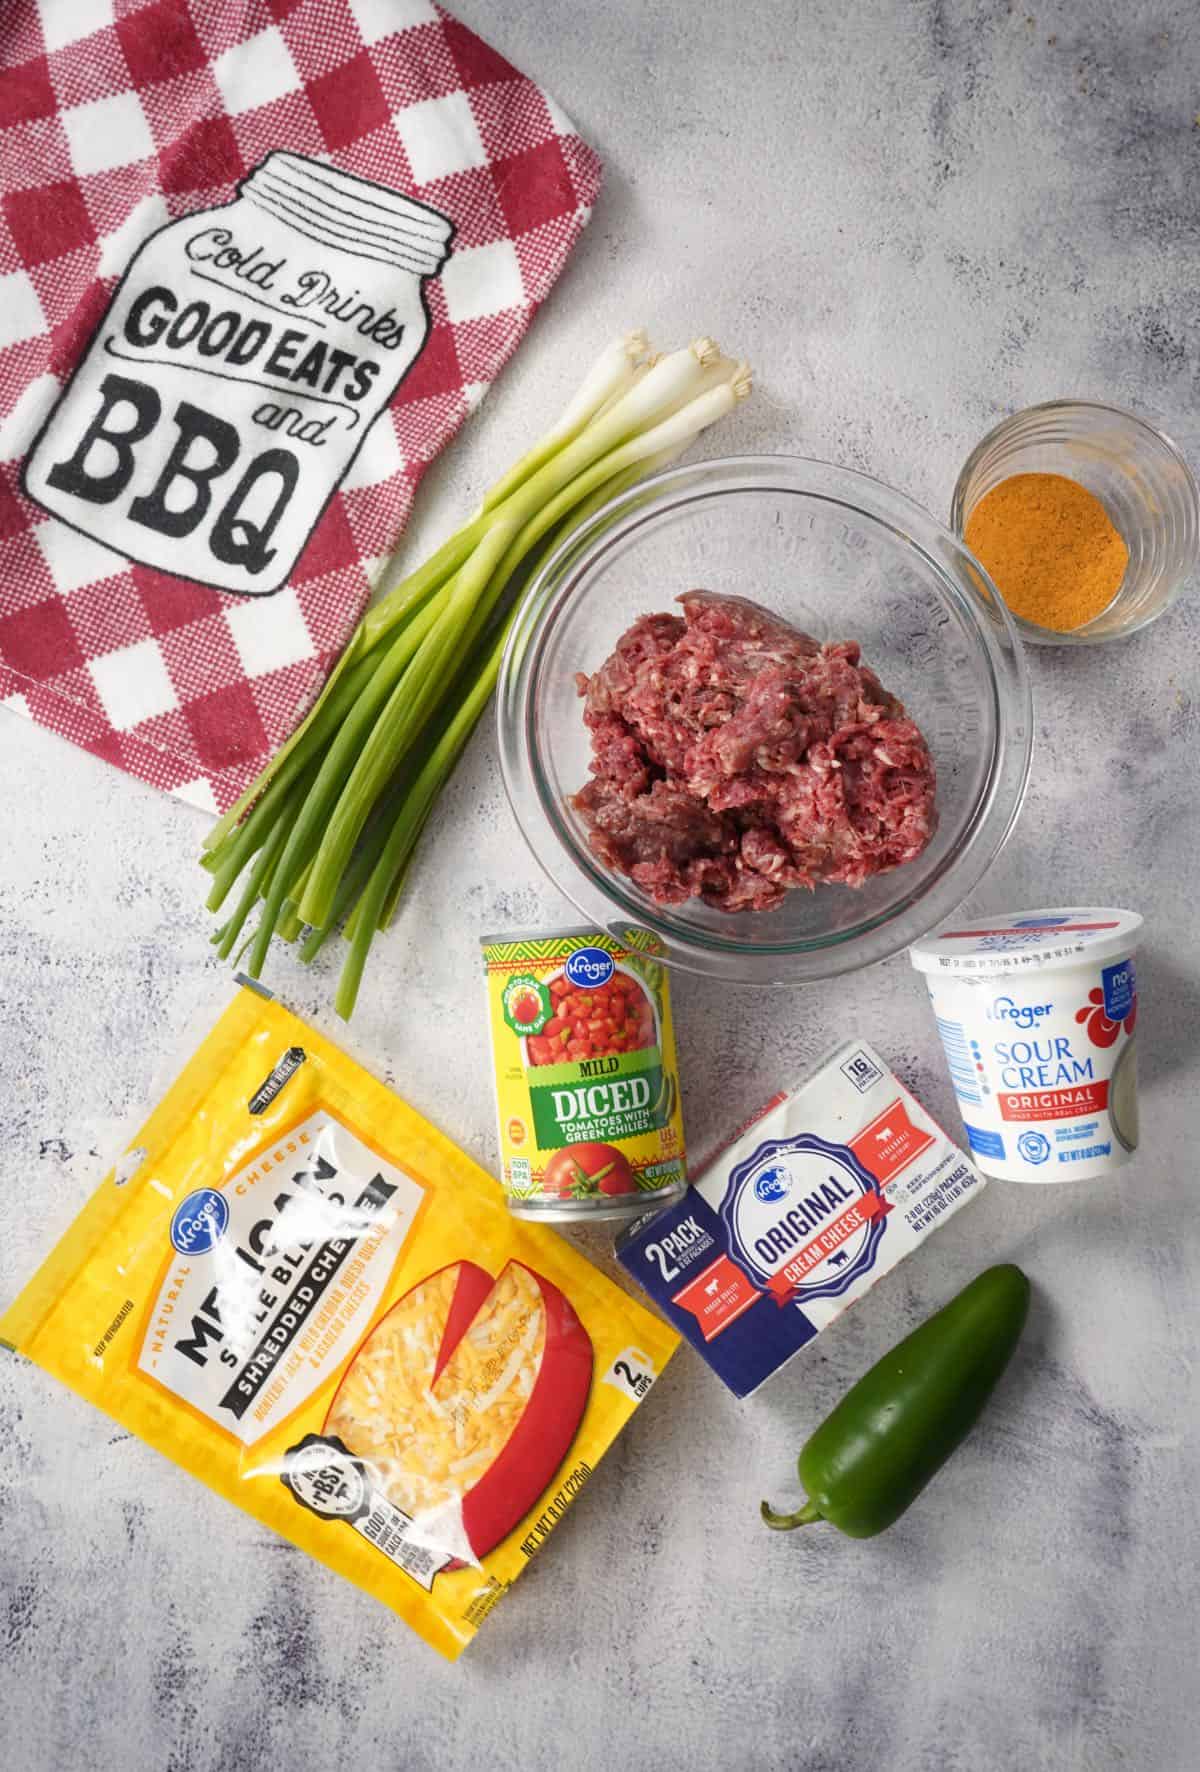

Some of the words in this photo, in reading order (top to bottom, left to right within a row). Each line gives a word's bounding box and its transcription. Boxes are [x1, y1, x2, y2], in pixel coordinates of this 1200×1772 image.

[185, 228, 288, 291] Cold
[281, 271, 406, 351] Drinks
[124, 286, 272, 367] GOOD
[263, 329, 381, 402] EATS
[252, 402, 338, 446] and
[45, 374, 300, 575] BBQ
[569, 956, 611, 979] Kroger
[579, 1057, 619, 1077] MILD
[849, 1059, 867, 1076] 16
[994, 1037, 1073, 1065] SOUR
[1001, 1057, 1094, 1089] CREAM
[551, 1078, 650, 1122] DICED
[1007, 1087, 1094, 1109] ORIGINAL
[560, 1114, 621, 1133] TOMATOES
[624, 1109, 650, 1121] WITH
[566, 1129, 605, 1142] GREEN
[607, 1119, 649, 1136] CHILIES
[235, 1133, 310, 1196] CHEESE
[940, 1164, 969, 1197] PACKAGES
[177, 1195, 219, 1249] Kroger
[660, 1215, 705, 1259] PACK
[754, 1175, 854, 1264] ORIGINAL
[912, 1218, 926, 1232] NET
[645, 1244, 680, 1283] 2
[784, 1244, 825, 1282] CREAM
[821, 1207, 865, 1250] CHEESE
[152, 1266, 191, 1352] NATURAL
[238, 1287, 315, 1395] SHREDDED
[312, 1197, 377, 1282] CHEE
[219, 1289, 277, 1368] SLE
[613, 1361, 642, 1387] 2
[634, 1374, 652, 1398] CUPS
[520, 1533, 538, 1558] NET
[535, 1515, 553, 1537] WT
[548, 1506, 560, 1520] 8
